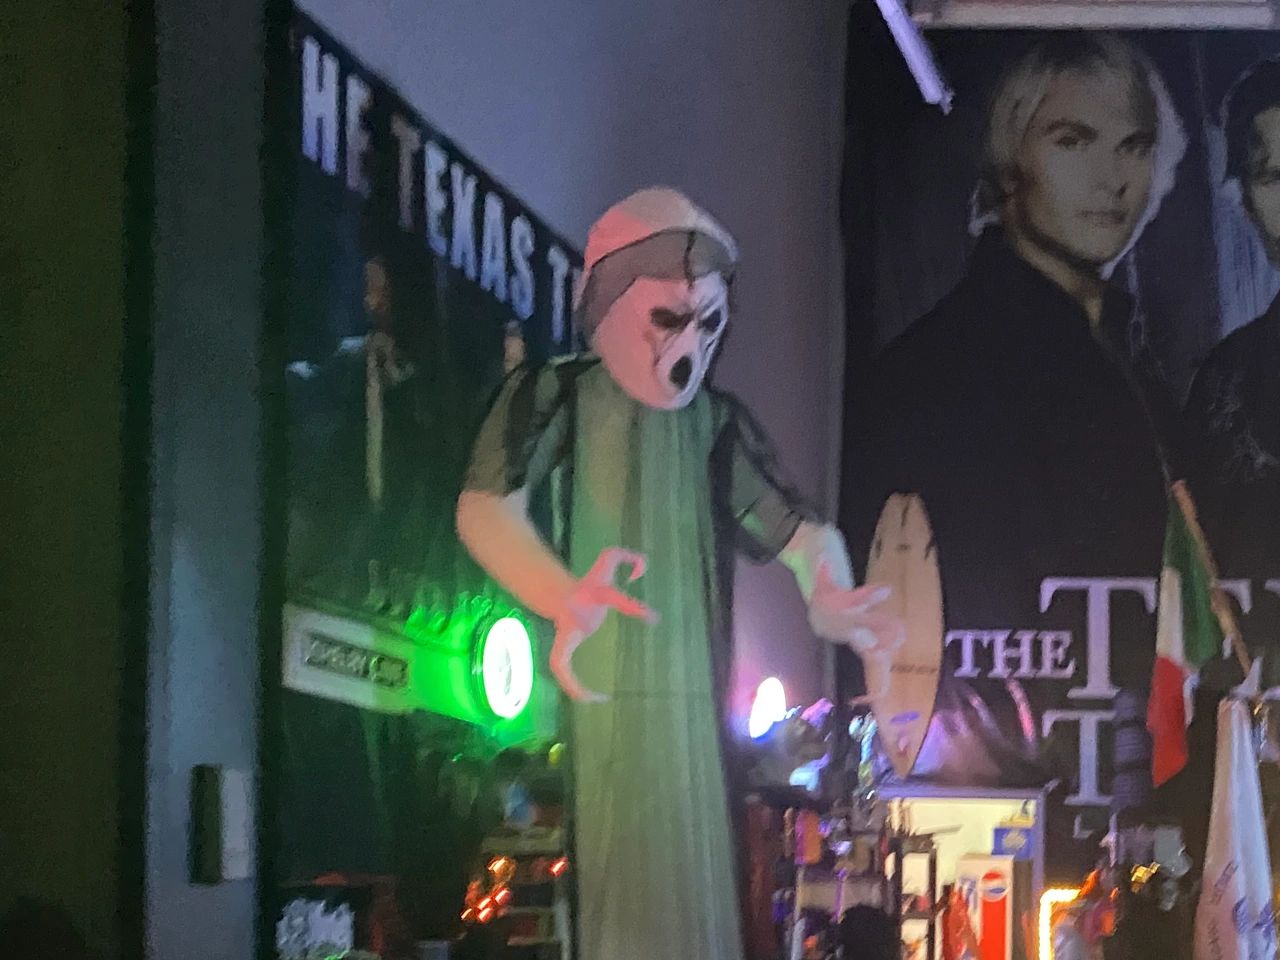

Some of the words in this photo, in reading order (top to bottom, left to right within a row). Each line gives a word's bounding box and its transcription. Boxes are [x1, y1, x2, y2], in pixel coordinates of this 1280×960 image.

[299, 35, 373, 200] HE
[390, 112, 537, 321] TEXAS
[945, 628, 1077, 680] THE
